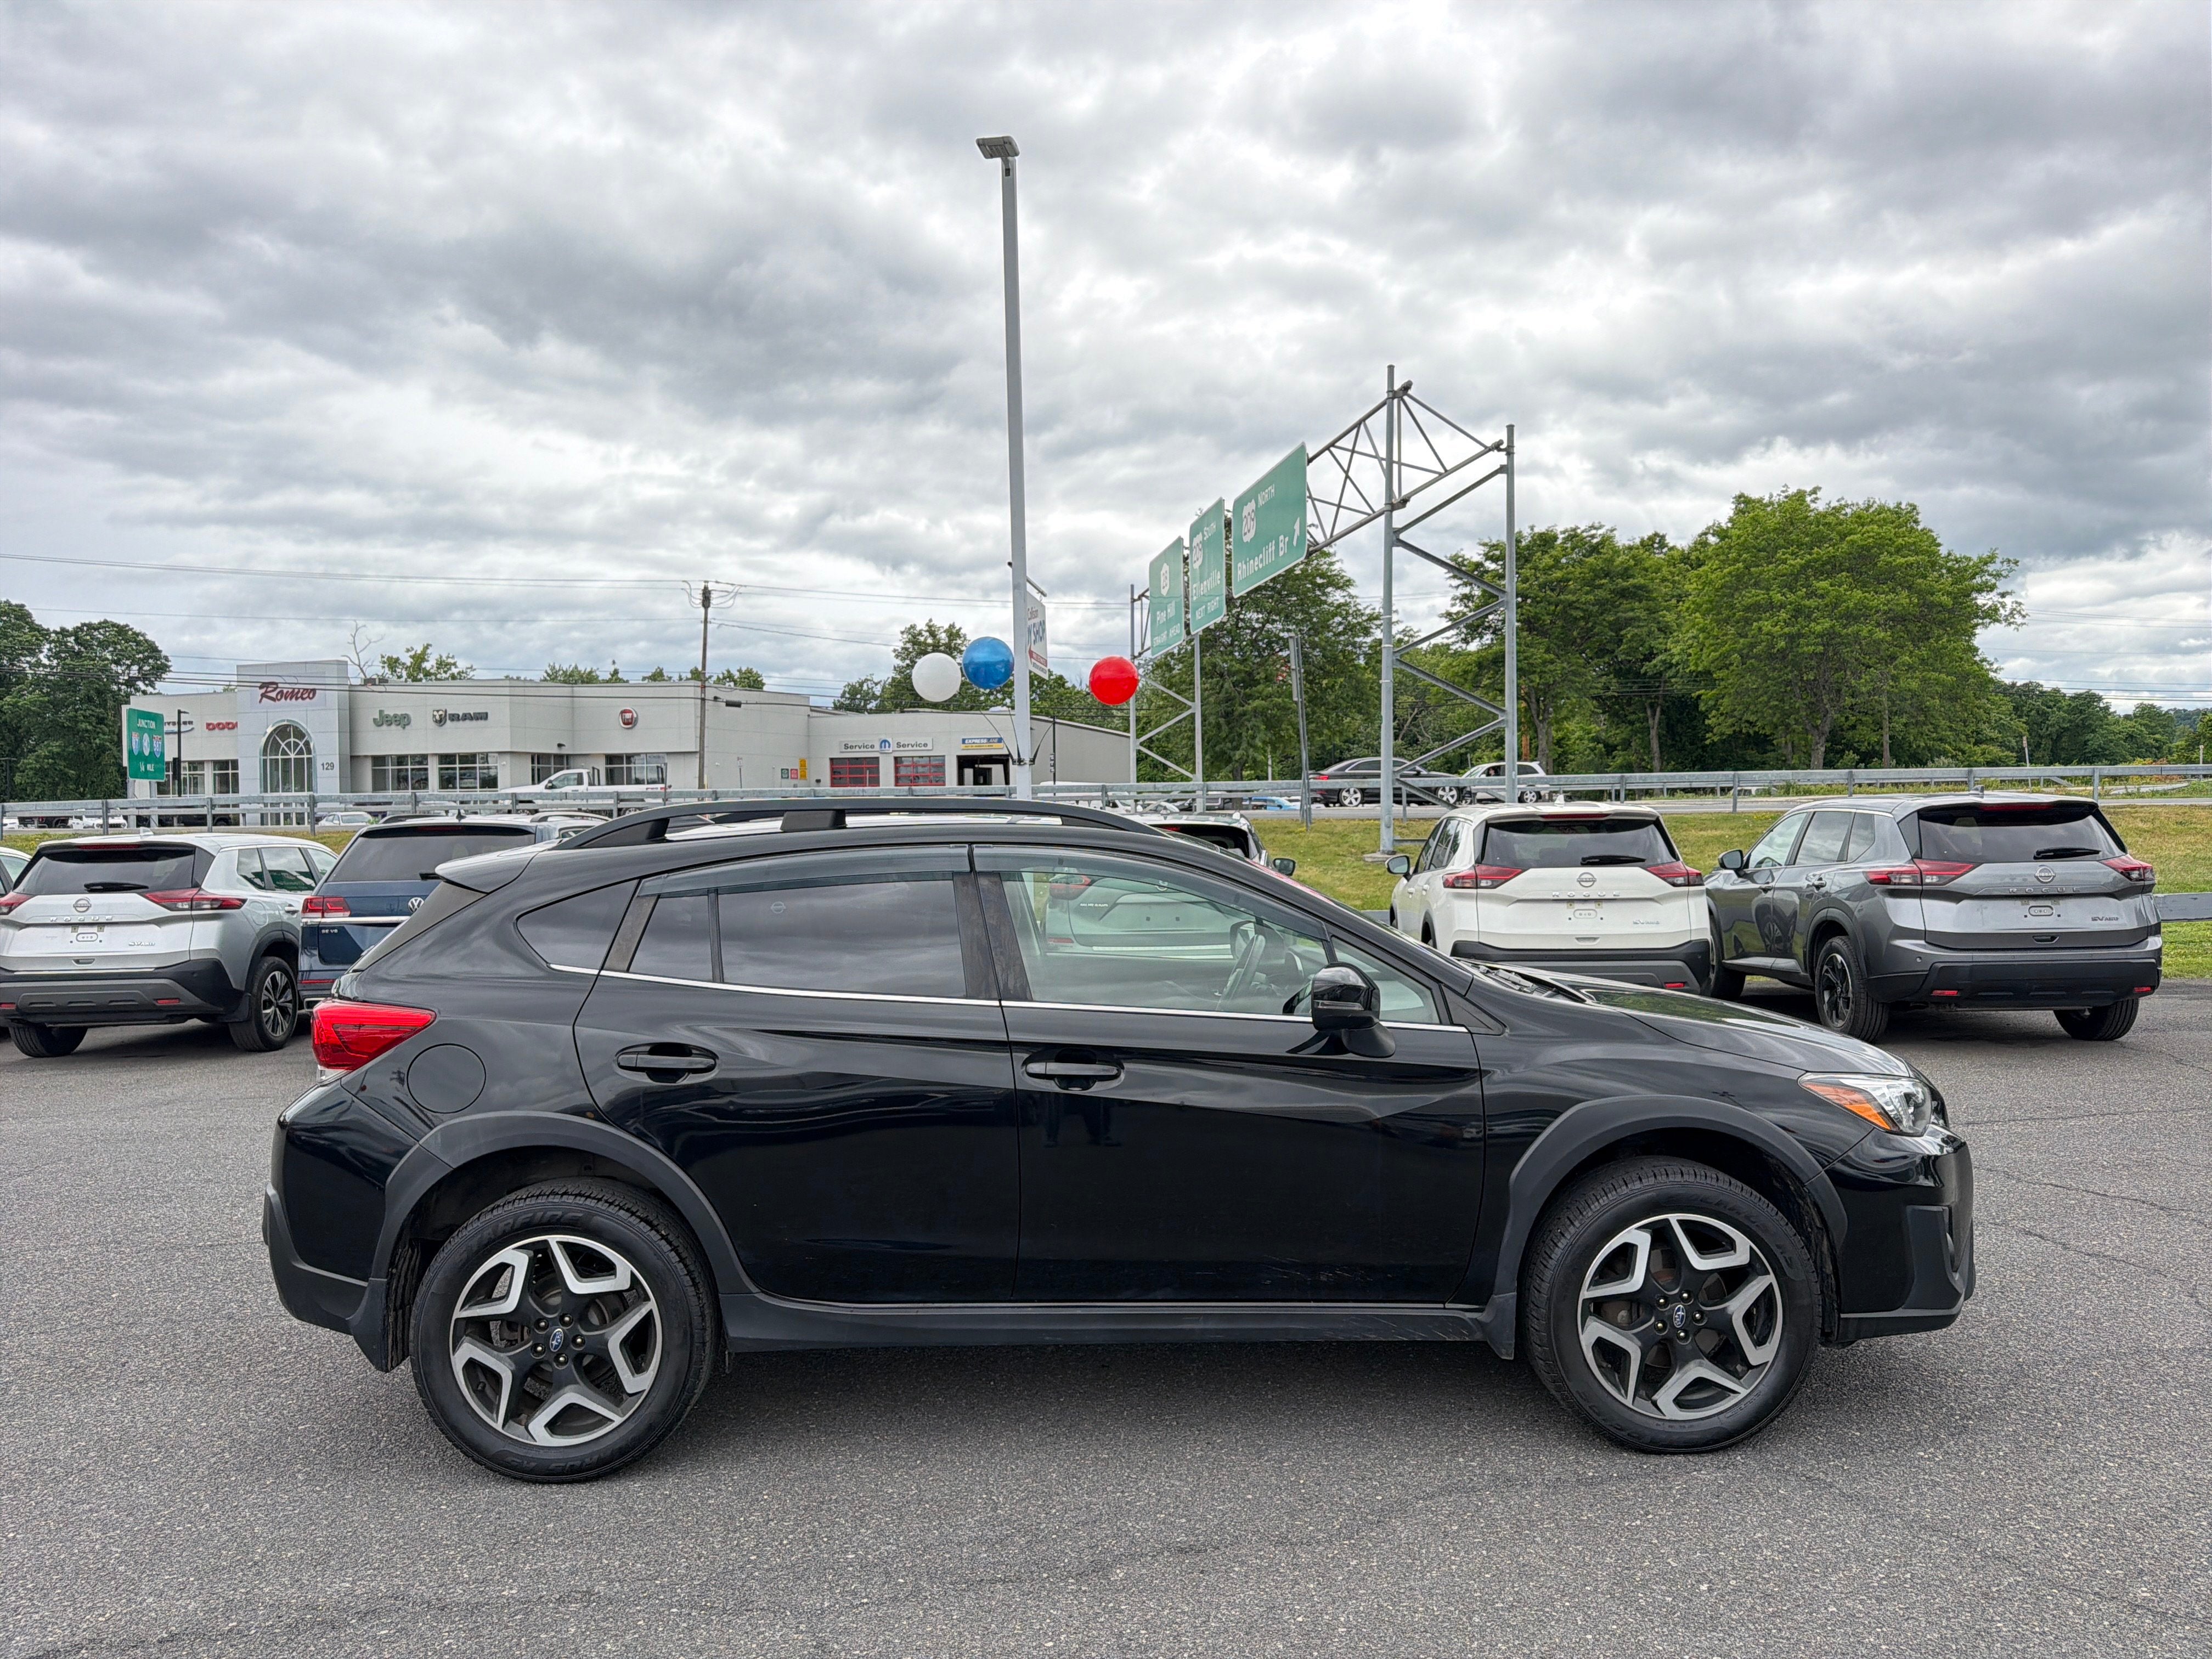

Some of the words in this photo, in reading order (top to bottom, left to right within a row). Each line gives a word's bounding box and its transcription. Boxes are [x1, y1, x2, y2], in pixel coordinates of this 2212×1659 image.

[1243, 509, 1256, 537] 209
[1258, 484, 1276, 508] NORTH
[1237, 539, 1276, 582] Rhinecliff
[1279, 534, 1289, 557] Br
[1192, 568, 1221, 601] Ellenville
[1032, 619, 1046, 646] SHOP
[258, 681, 317, 704] Romeo
[137, 718, 156, 729] JUNCTION
[206, 721, 238, 731] DOD
[373, 709, 411, 729] Jeep
[448, 711, 488, 722] RAM
[321, 762, 335, 770] 129
